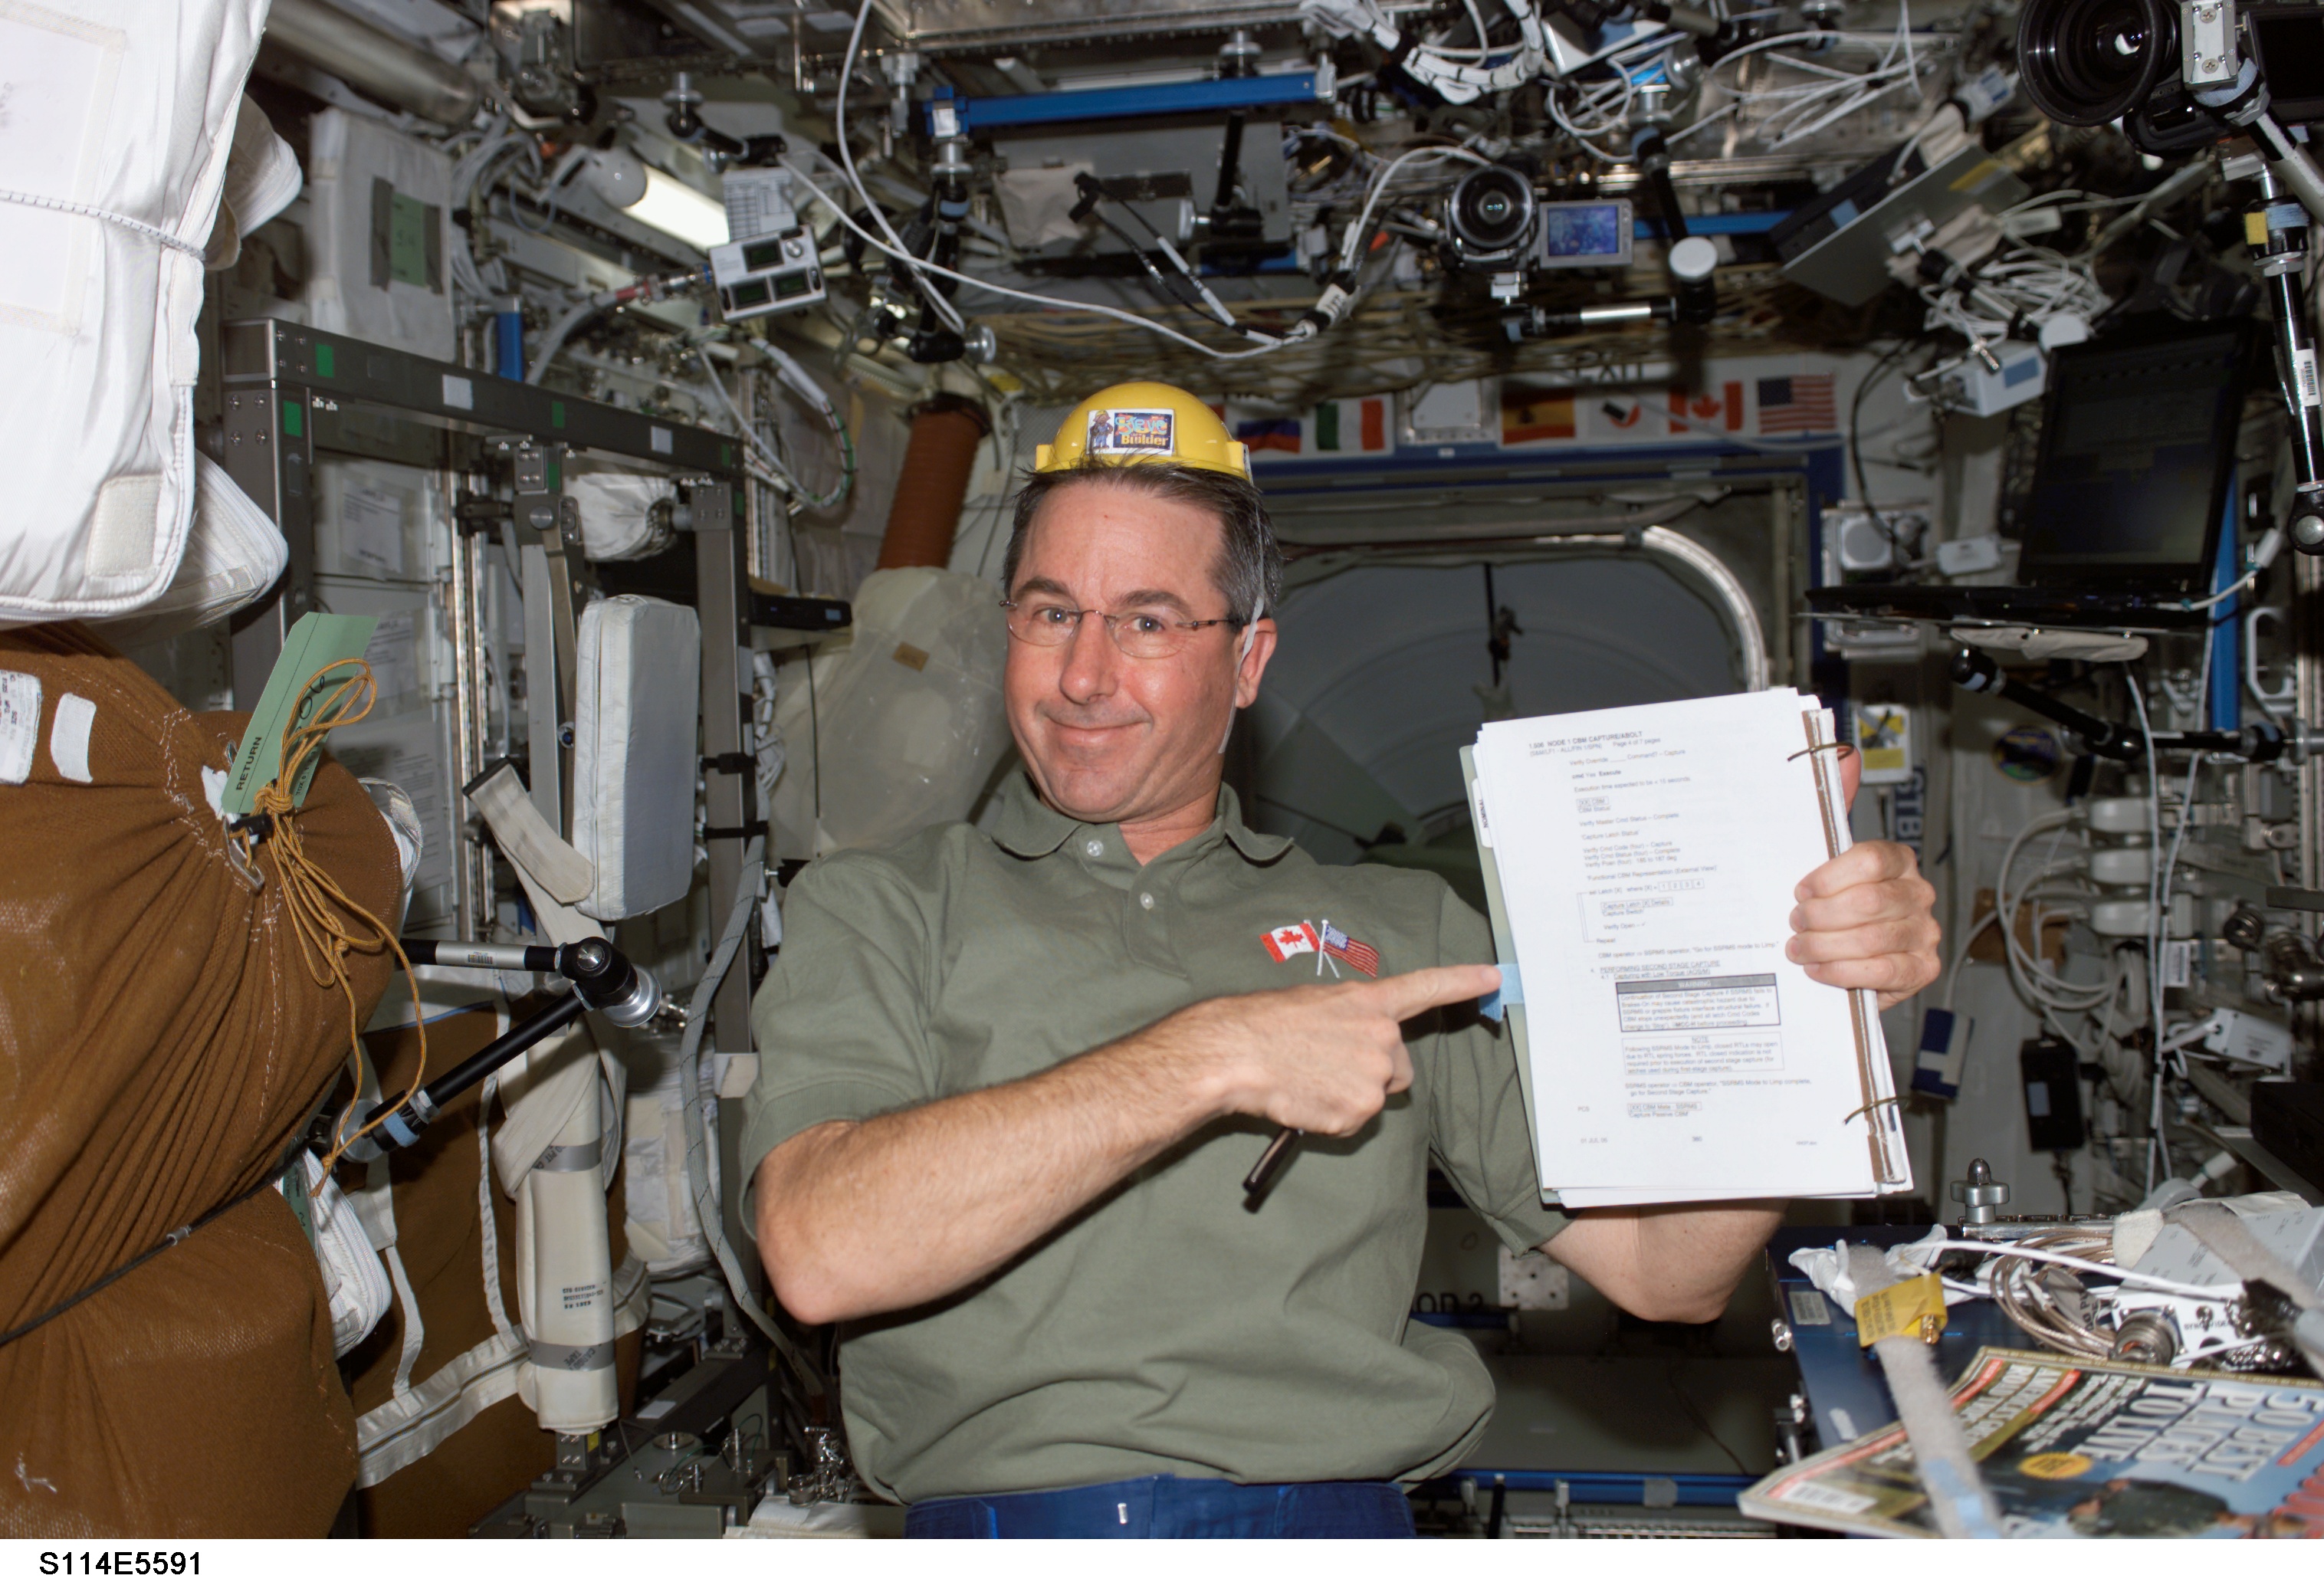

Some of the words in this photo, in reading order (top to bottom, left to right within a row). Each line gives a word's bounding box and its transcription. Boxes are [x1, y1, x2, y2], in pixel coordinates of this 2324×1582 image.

[1114, 416, 1168, 435] Steve
[1121, 435, 1170, 446] Builder
[236, 737, 262, 791] RETURN
[1570, 759, 1584, 767] Verify
[1478, 799, 1489, 829] NOMINAL
[1653, 812, 1680, 822] Complete
[1600, 965, 1640, 973] PERFORMING
[1691, 960, 1721, 968] CAPTURE
[1416, 1292, 1459, 1313] OD
[2130, 1380, 2206, 1416] TO
[2252, 1389, 2324, 1427] 50
[2070, 1414, 2174, 1463] LIVE
[2135, 1388, 2265, 1467] PLACES
[2192, 1426, 2299, 1483] BEST
